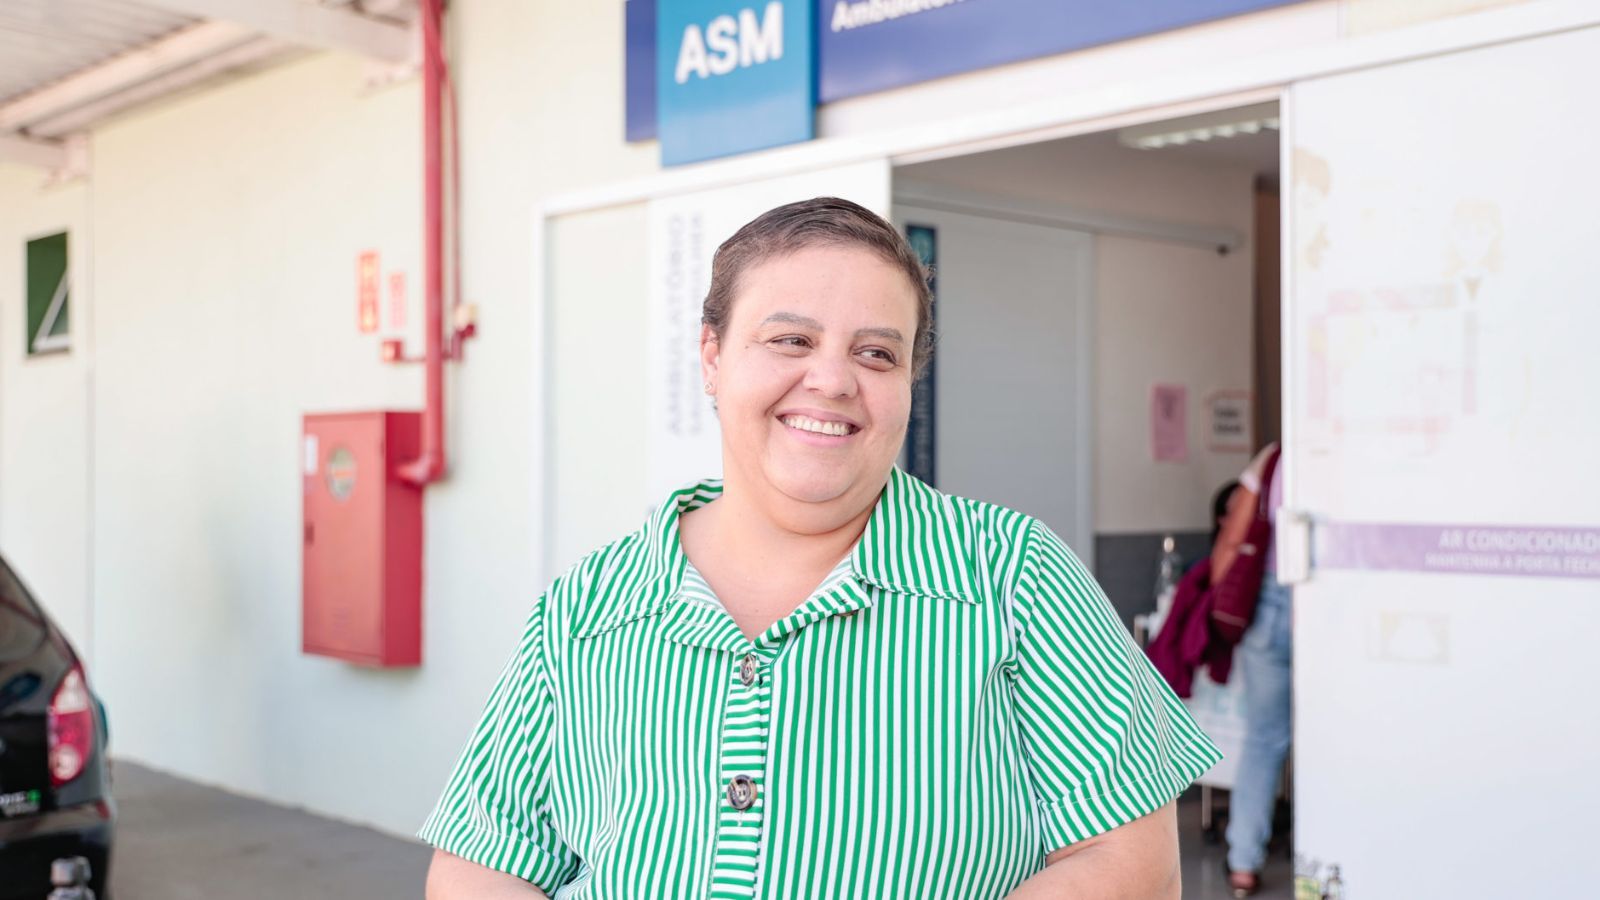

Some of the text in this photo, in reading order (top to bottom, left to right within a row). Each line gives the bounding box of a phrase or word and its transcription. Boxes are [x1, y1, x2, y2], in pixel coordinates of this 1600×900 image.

[675, 1, 783, 84] ASM
[1439, 529, 1600, 554] AR CONDICIONAD
